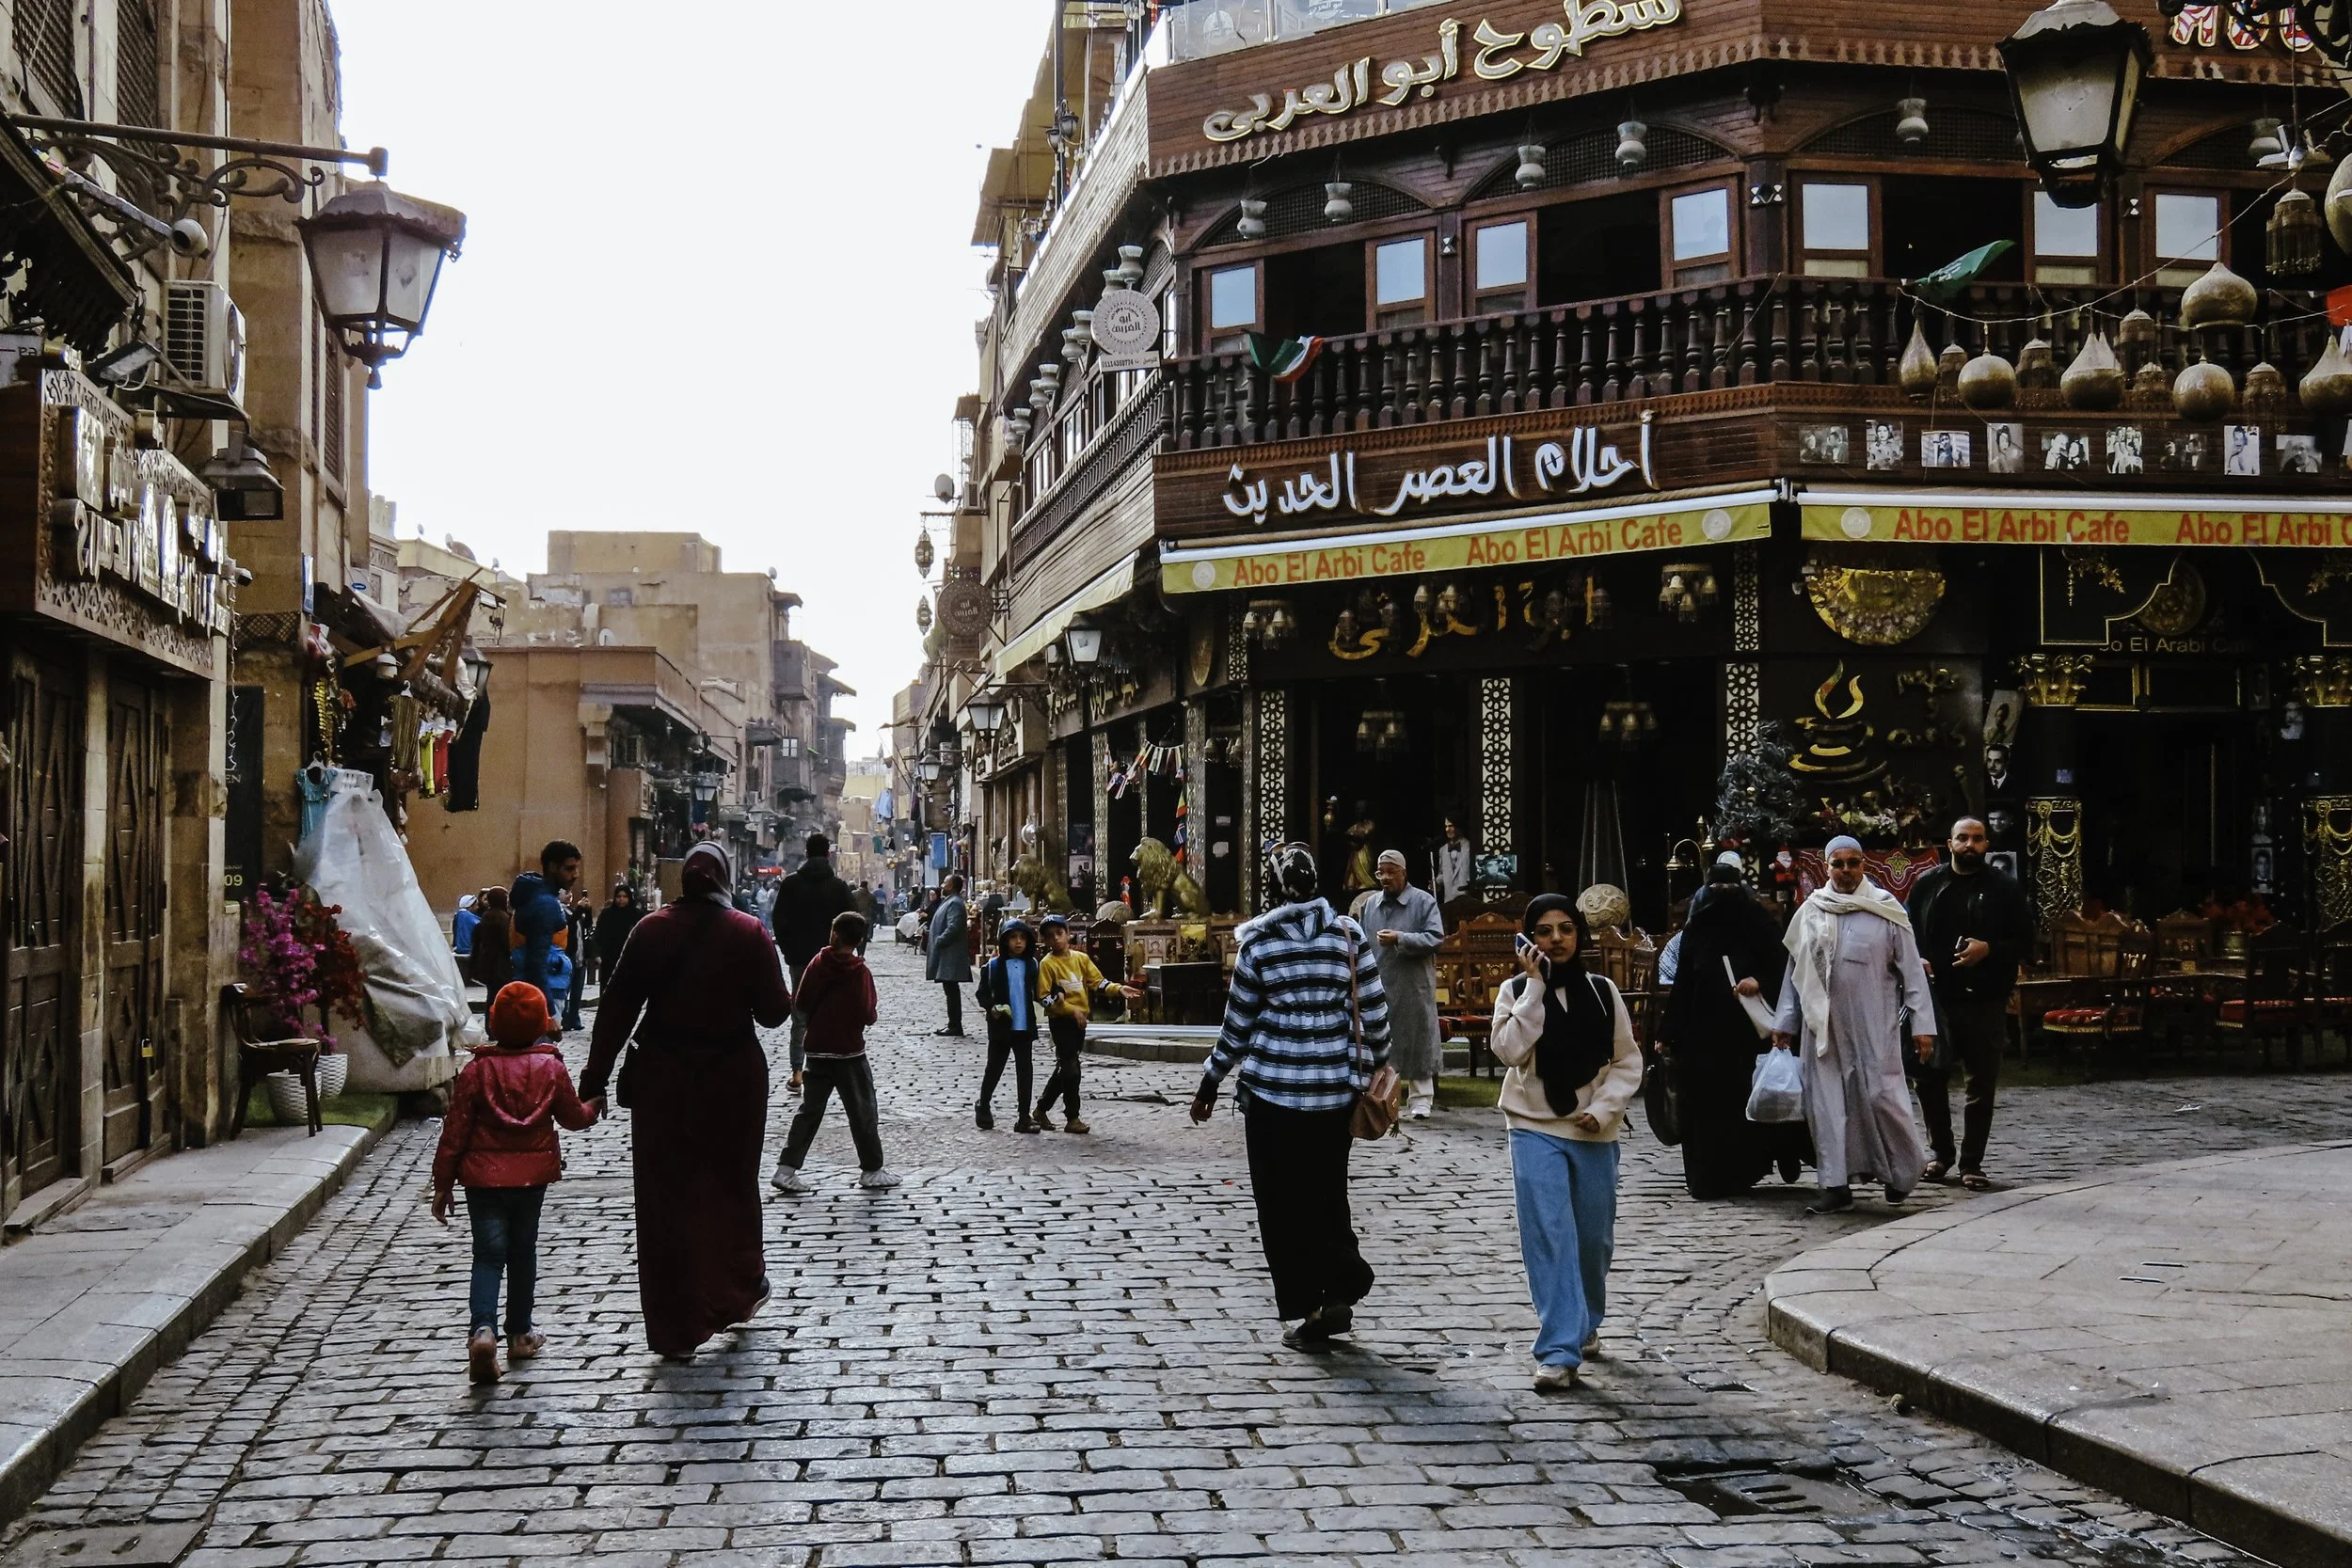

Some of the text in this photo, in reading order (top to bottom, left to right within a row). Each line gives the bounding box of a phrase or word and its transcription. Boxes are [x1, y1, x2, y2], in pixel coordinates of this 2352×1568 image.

[1376, 18, 1464, 106] أبو
[1473, 0, 1680, 80] سطوح
[1222, 409, 1660, 525] أحلام العصر الحديث
[1466, 516, 1683, 565] Abo El Arbi Cafe
[1893, 508, 2131, 543] Abo El Arbi Cafe
[2176, 514, 2233, 545] Abo
[2243, 514, 2268, 546] El
[2276, 515, 2332, 546] Arbi
[1233, 542, 1426, 586] Abo El Arbi Cafe
[2130, 637, 2149, 652] El
[2155, 637, 2206, 653] Arabi
